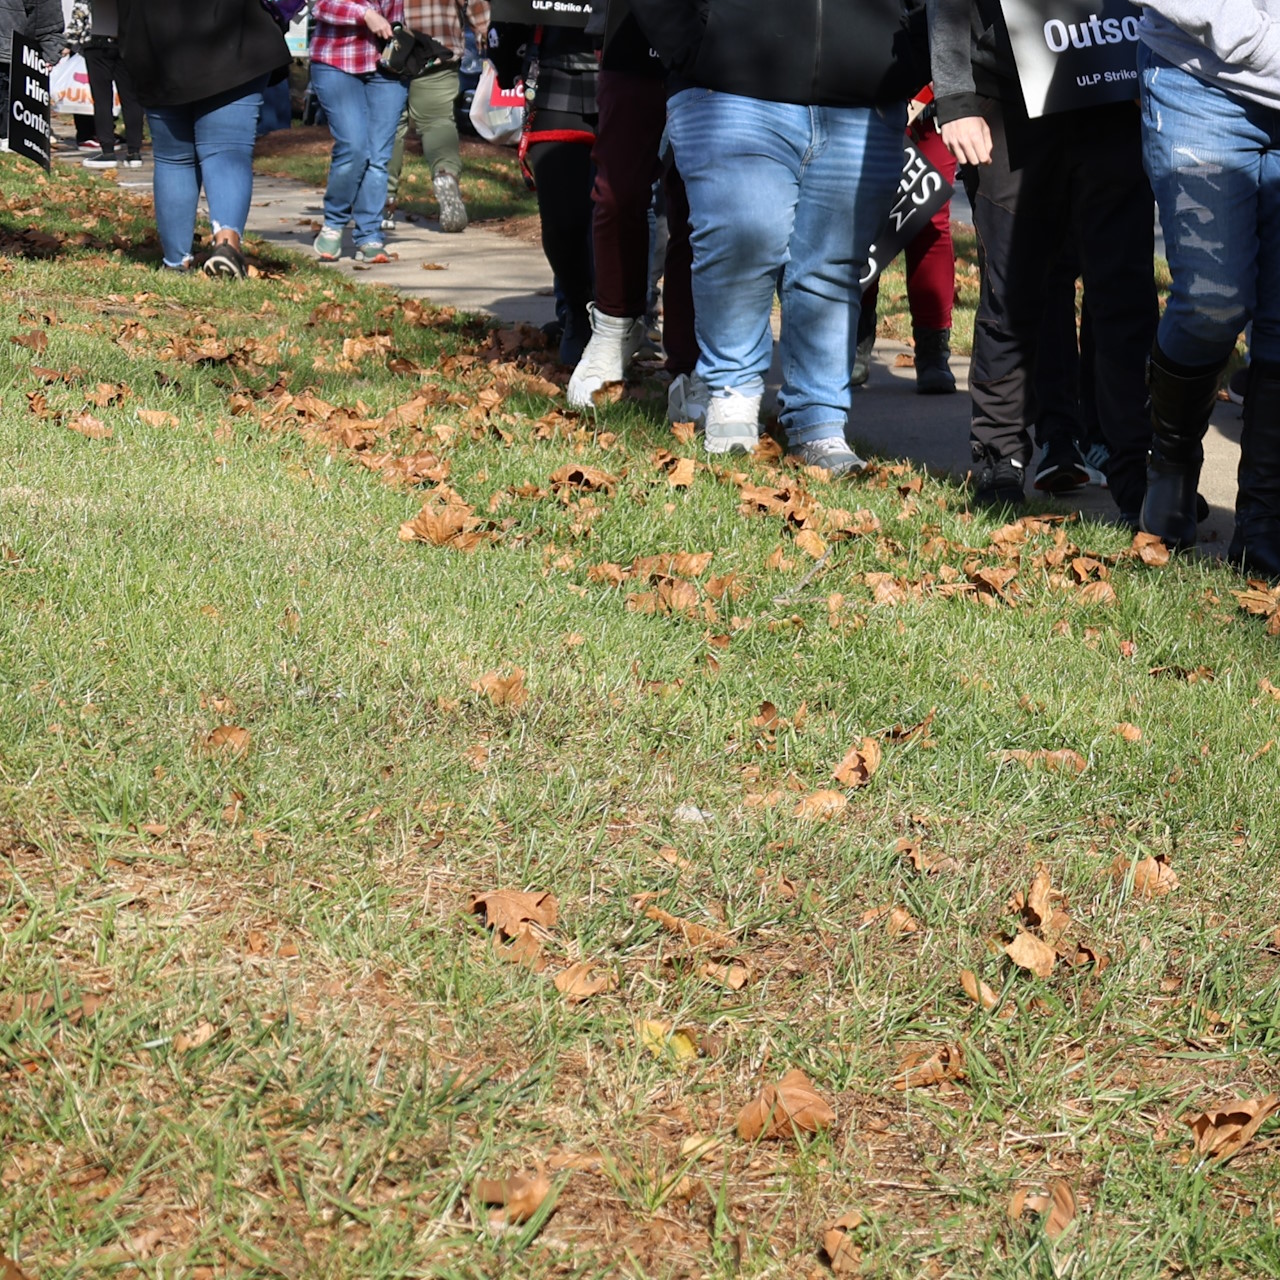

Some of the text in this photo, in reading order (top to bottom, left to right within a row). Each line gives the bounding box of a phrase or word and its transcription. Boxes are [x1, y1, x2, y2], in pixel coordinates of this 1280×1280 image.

[532, 0, 552, 10] ULP
[554, 2, 581, 13] Strike
[1076, 69, 1138, 87] ULP Strike
